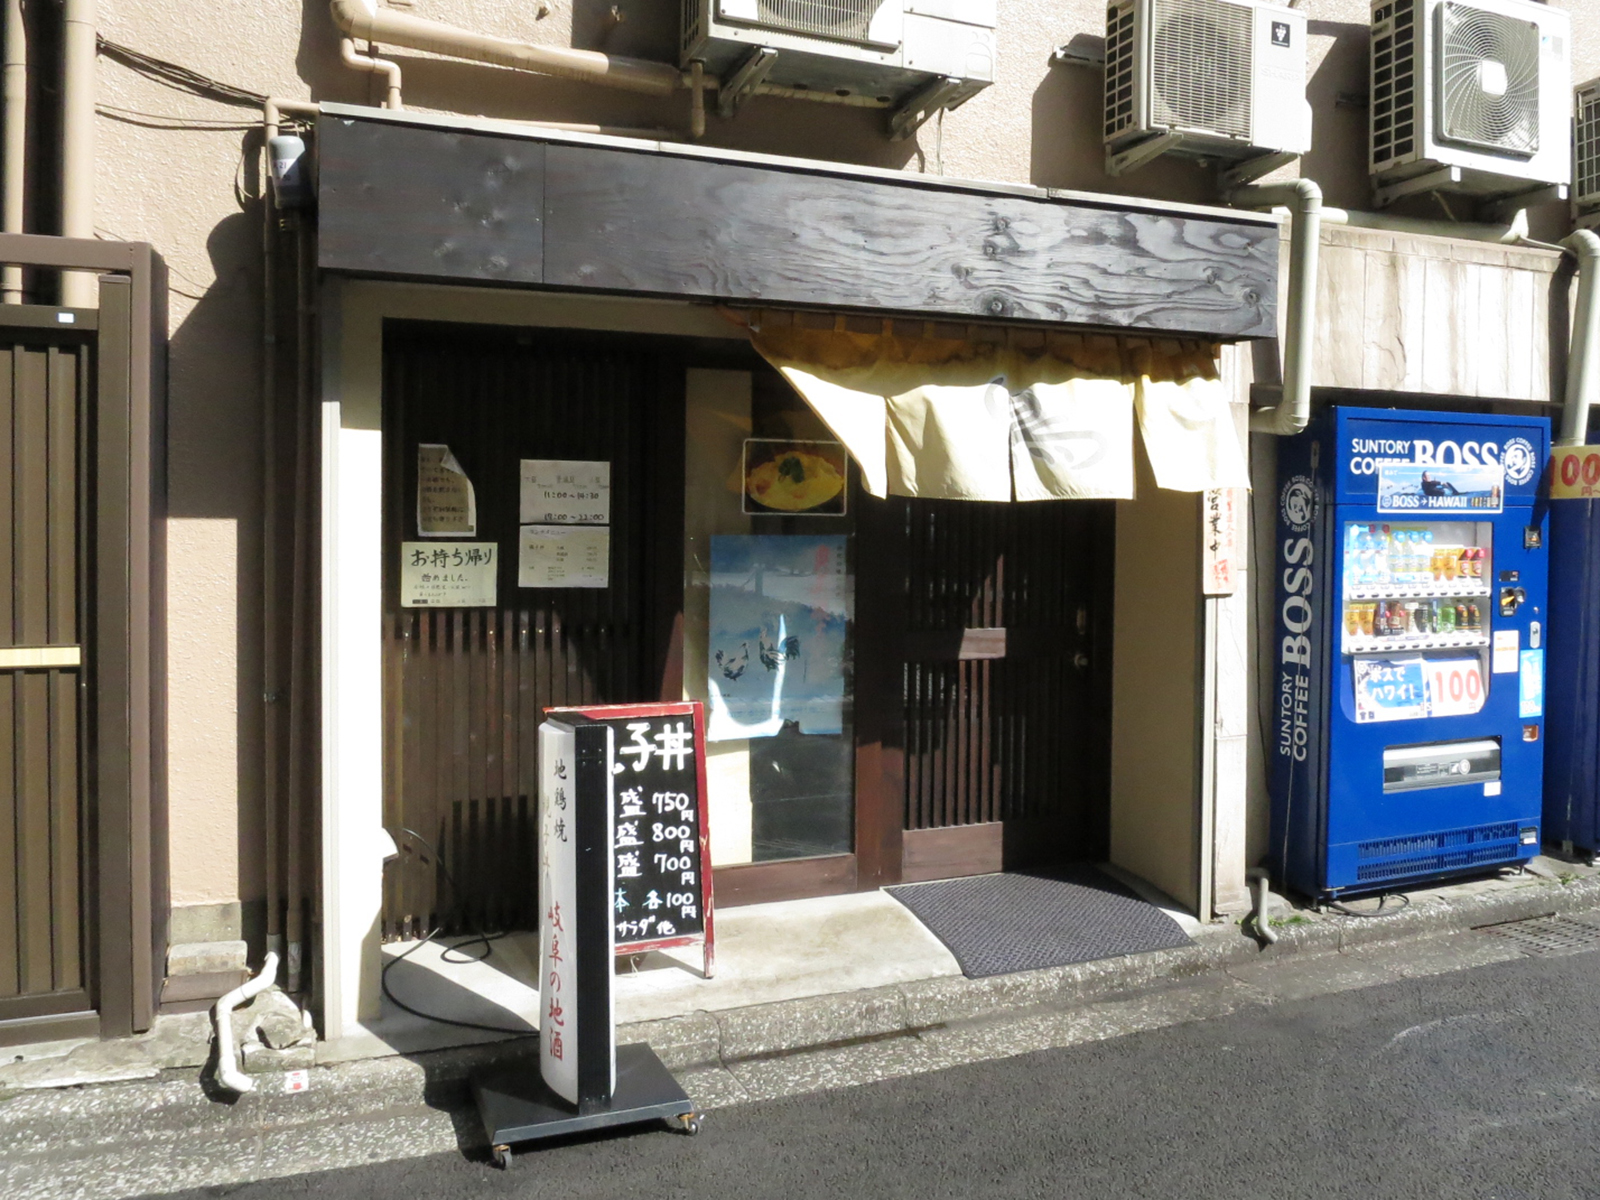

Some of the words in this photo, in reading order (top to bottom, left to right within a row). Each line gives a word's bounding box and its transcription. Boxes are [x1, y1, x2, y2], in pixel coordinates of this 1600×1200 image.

[1352, 437, 1411, 454] SUNTORY
[1413, 439, 1500, 466] BOSS
[1391, 495, 1420, 508] BOSS
[1428, 495, 1468, 508] HAWAII
[410, 547, 492, 568] お持ち帰り
[1282, 537, 1313, 669] BOSS
[1435, 668, 1480, 702] 100
[1280, 671, 1292, 756] SUNTORY
[1293, 674, 1308, 761] COFFEE
[652, 792, 694, 822] 750円
[652, 823, 694, 853] 800円
[654, 853, 695, 885] 700円
[666, 891, 697, 919] 100円
[547, 900, 564, 1062] 岐阜の地酒
